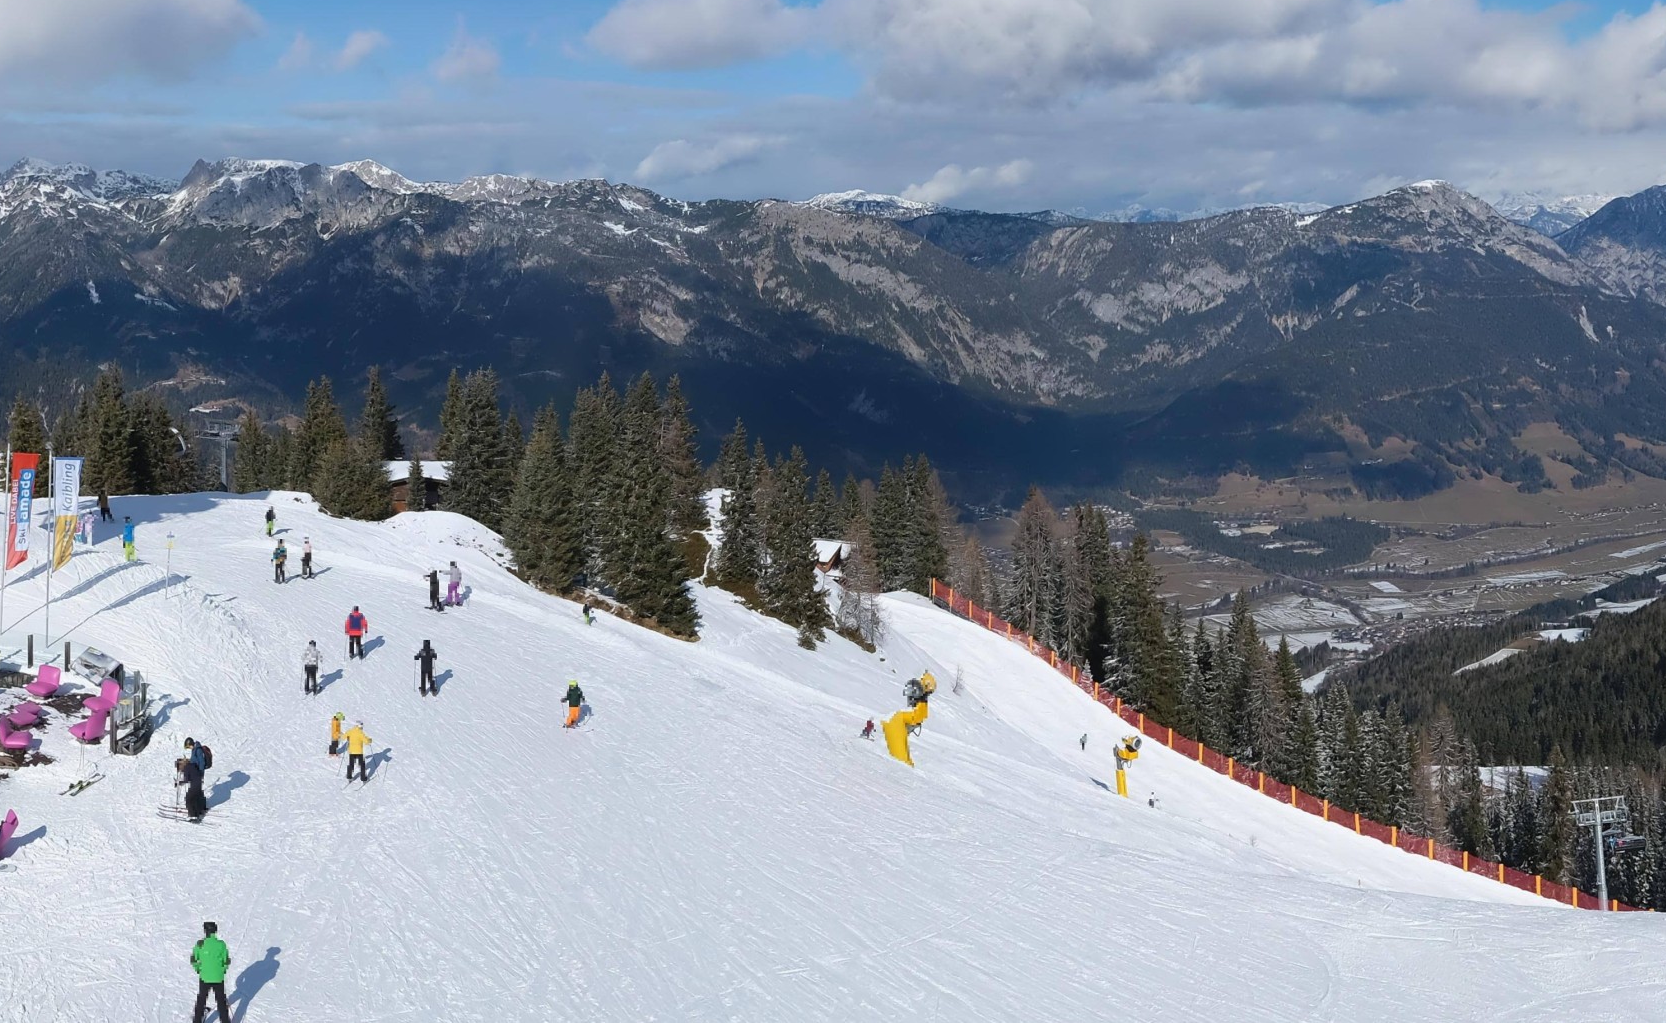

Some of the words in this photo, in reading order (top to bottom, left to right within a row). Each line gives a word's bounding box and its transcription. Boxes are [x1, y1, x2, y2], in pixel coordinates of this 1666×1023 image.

[11, 479, 19, 505] DABEI
[62, 463, 75, 512] Kaibling
[18, 528, 26, 545] Ski
